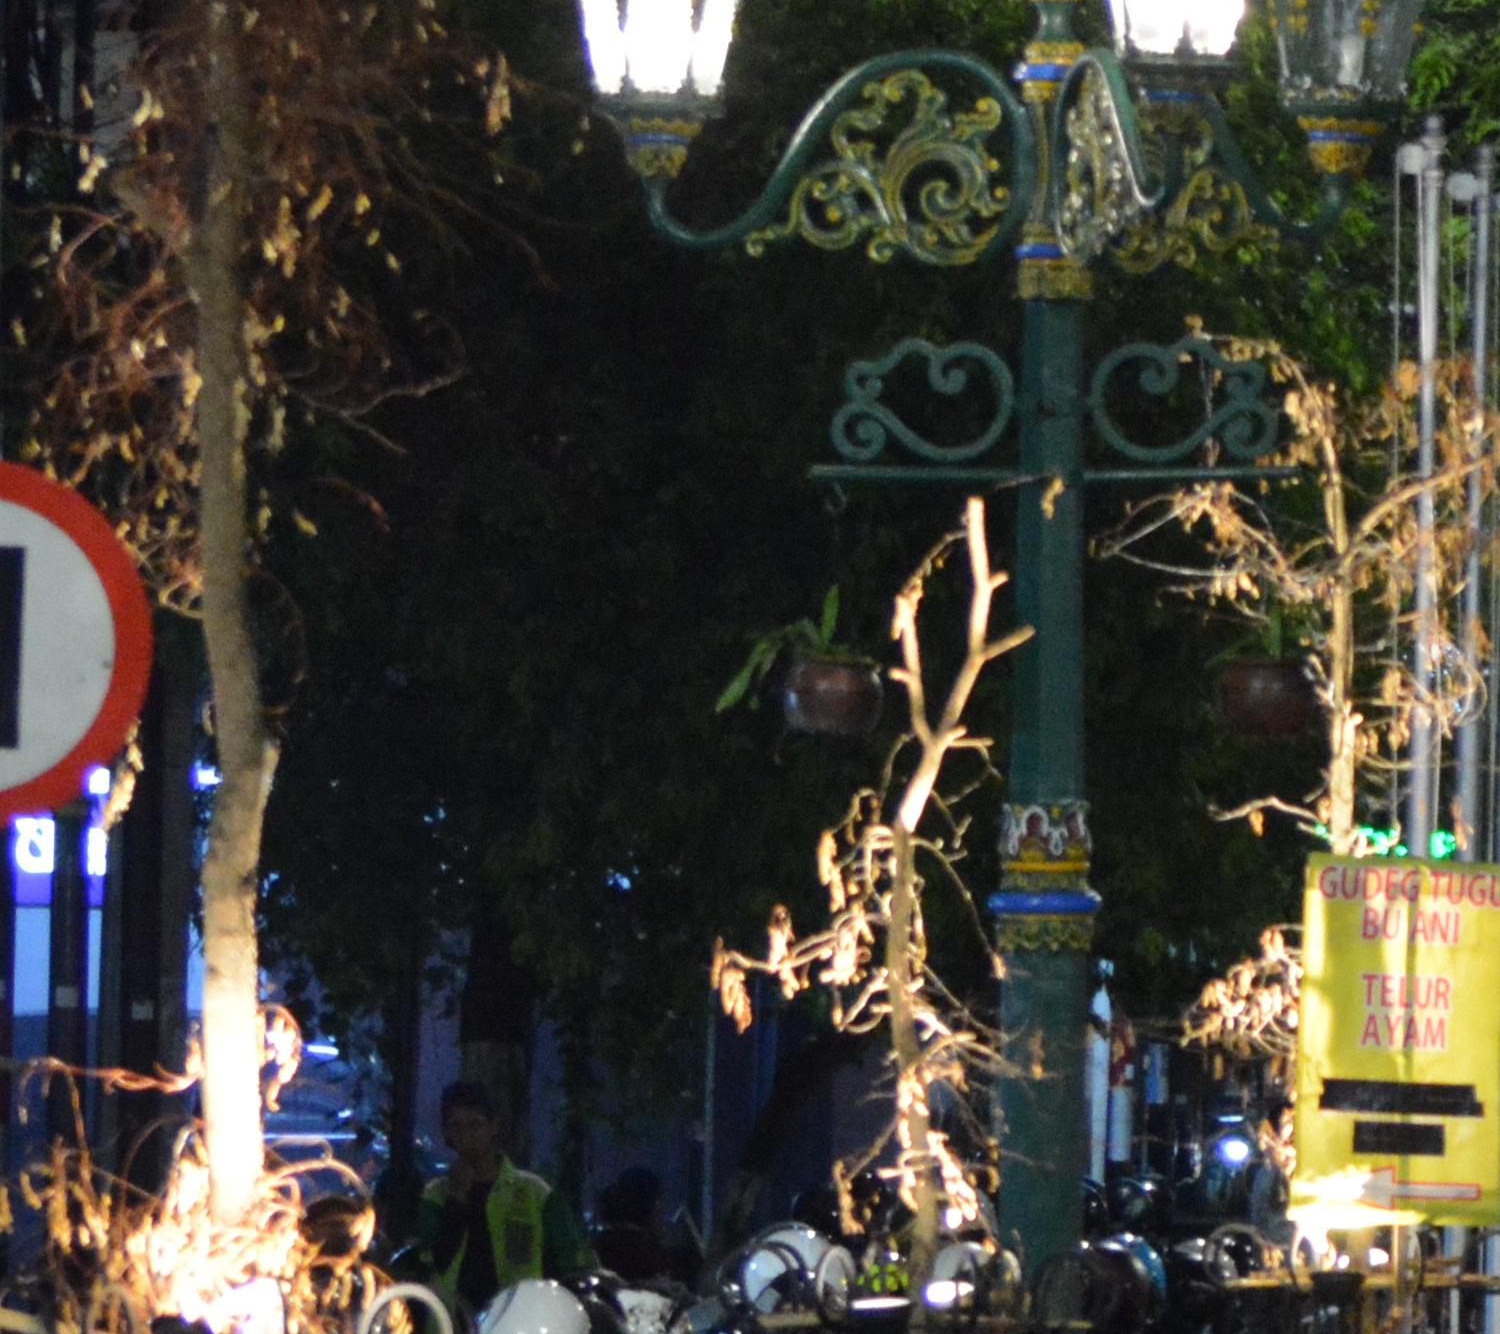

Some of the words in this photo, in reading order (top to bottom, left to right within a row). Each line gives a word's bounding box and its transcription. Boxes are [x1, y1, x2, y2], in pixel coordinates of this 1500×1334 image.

[1318, 866, 1421, 903] GUDEG
[1360, 909, 1400, 940] BU
[1413, 912, 1460, 946] ANI
[1361, 974, 1451, 1011] TELUR
[1360, 1013, 1447, 1049] AYAM
